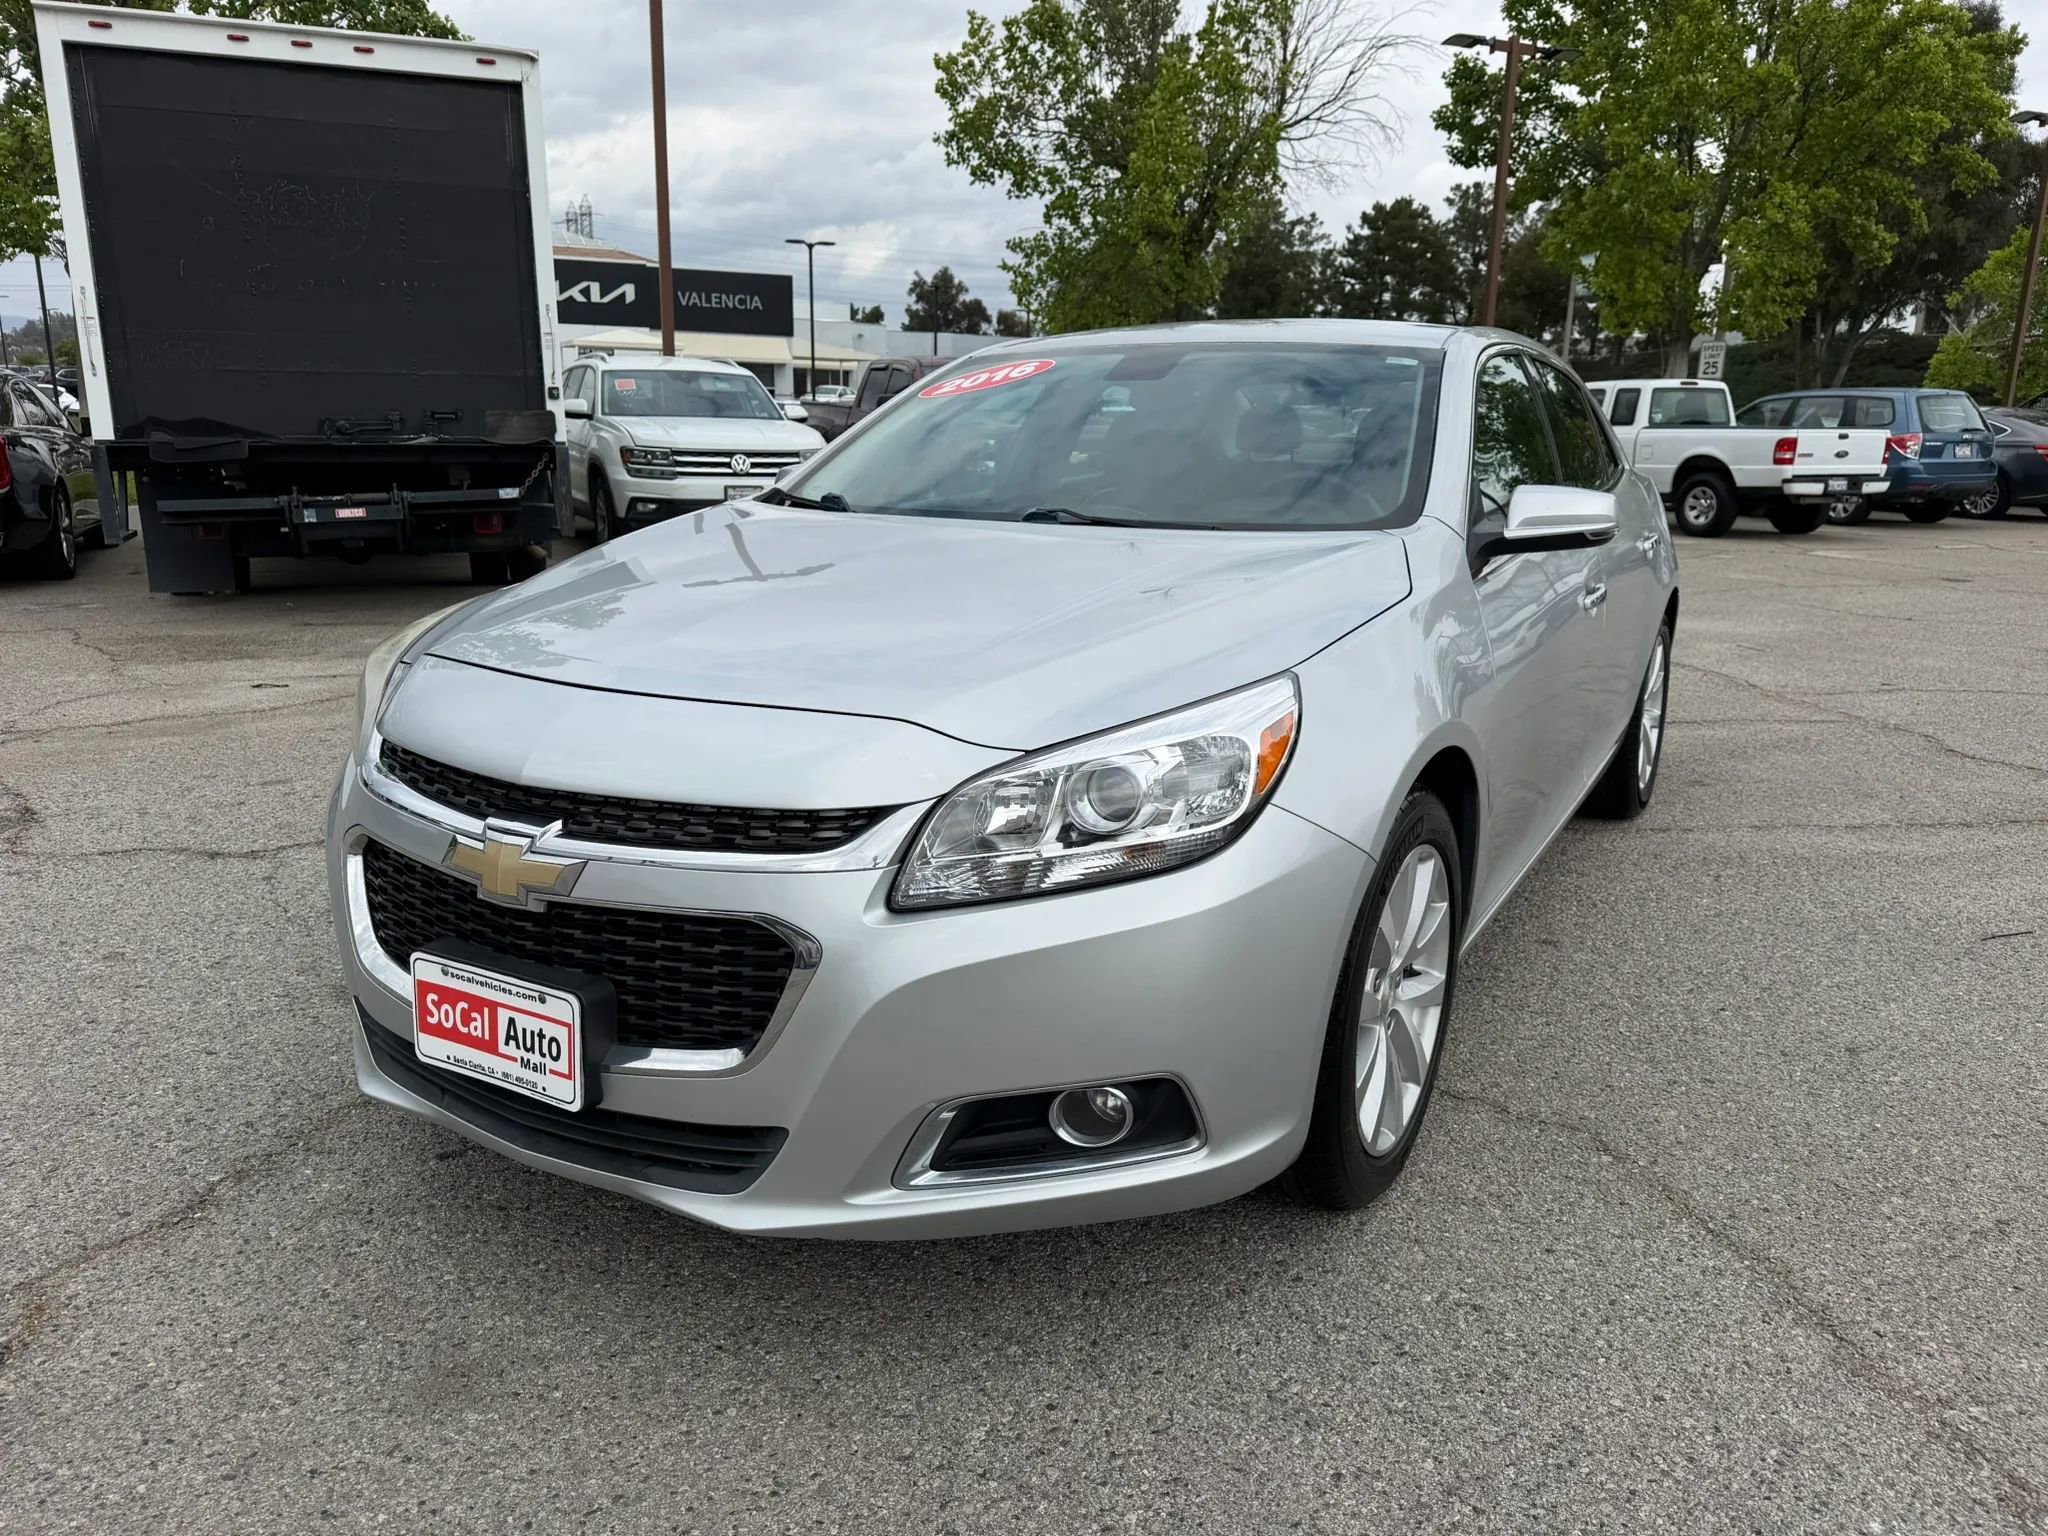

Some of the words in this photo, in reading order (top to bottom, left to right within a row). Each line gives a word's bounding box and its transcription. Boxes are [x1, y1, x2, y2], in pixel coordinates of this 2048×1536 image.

[555, 280, 636, 305] KIA
[677, 290, 764, 311] VALENCIA
[931, 361, 1041, 396] 2016
[1703, 361, 1719, 375] 25
[449, 970, 538, 1003] socalvehicles.com
[426, 992, 490, 1041] SoCal
[504, 1016, 562, 1062] Auto
[453, 1055, 468, 1066] Santa
[487, 1067, 495, 1075] CA
[520, 1056, 547, 1076] Mall
